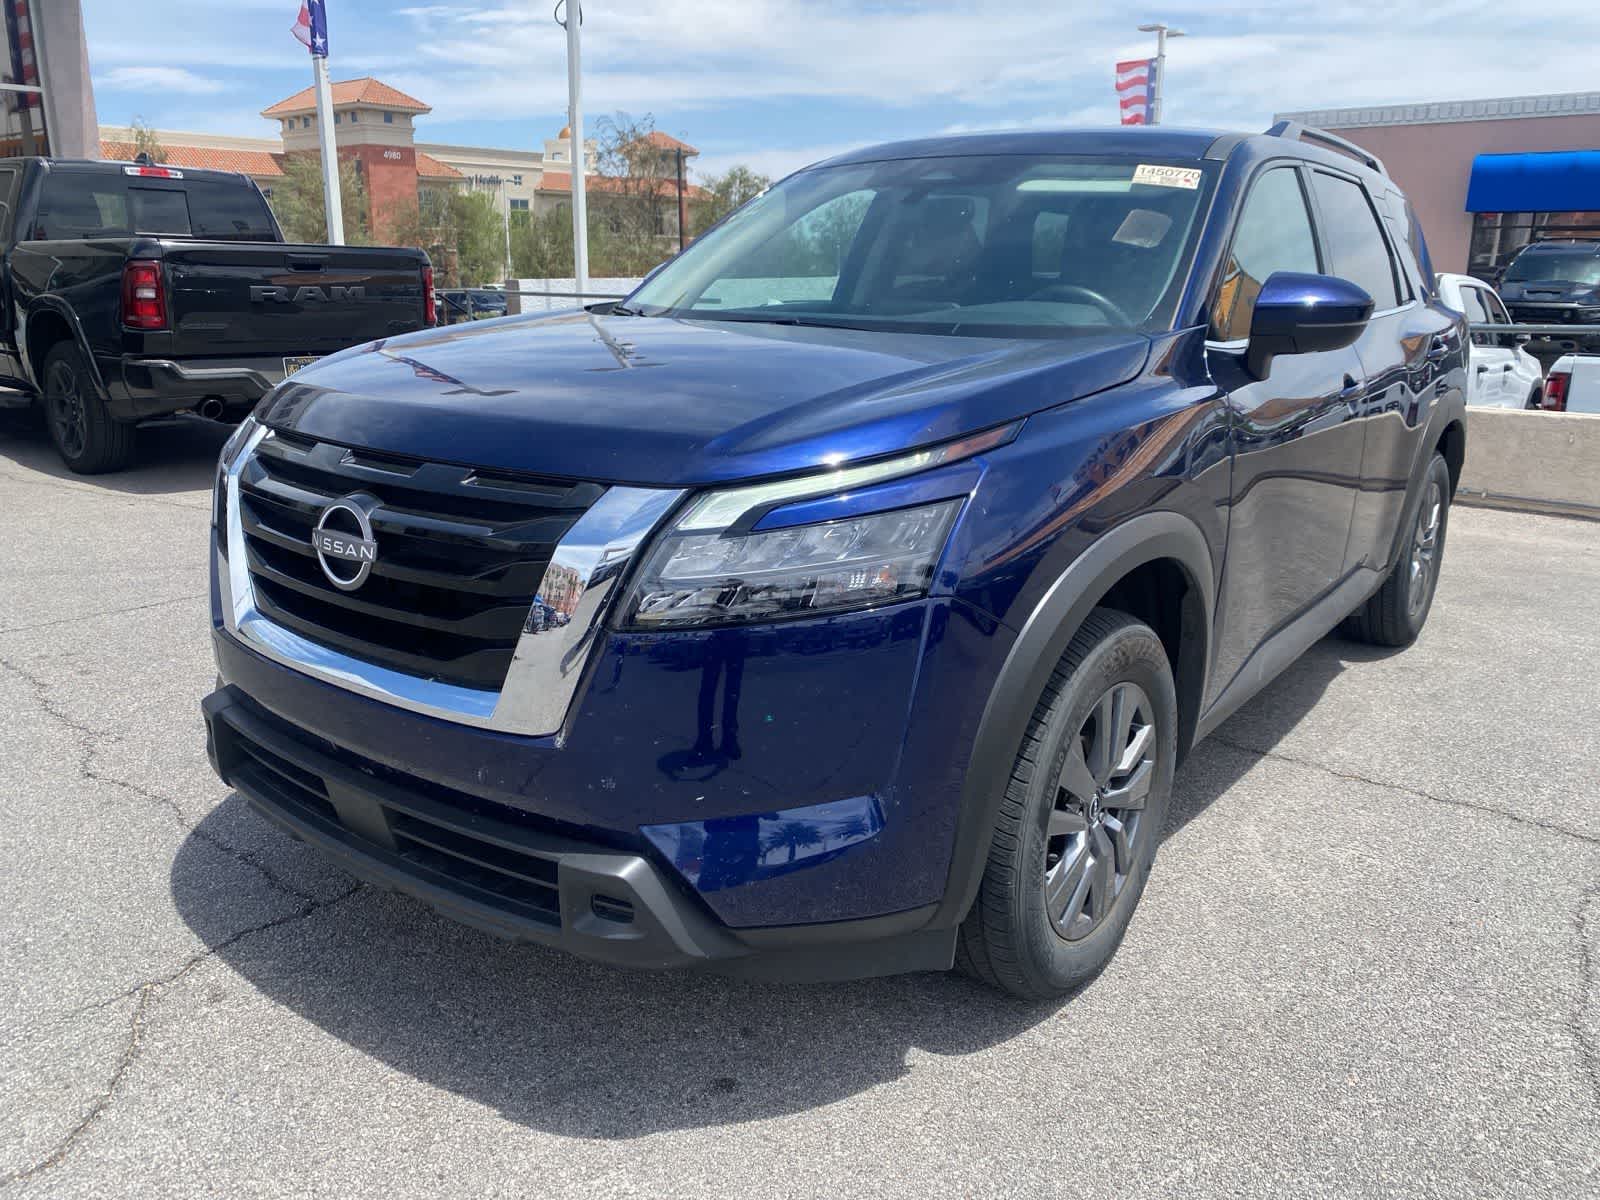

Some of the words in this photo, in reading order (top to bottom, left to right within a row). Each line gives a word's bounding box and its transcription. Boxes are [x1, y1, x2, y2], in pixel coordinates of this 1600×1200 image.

[383, 150, 401, 160] 4980
[1140, 167, 1201, 179] 1450770
[249, 285, 367, 303] RAM
[312, 531, 374, 560] NISSAN
